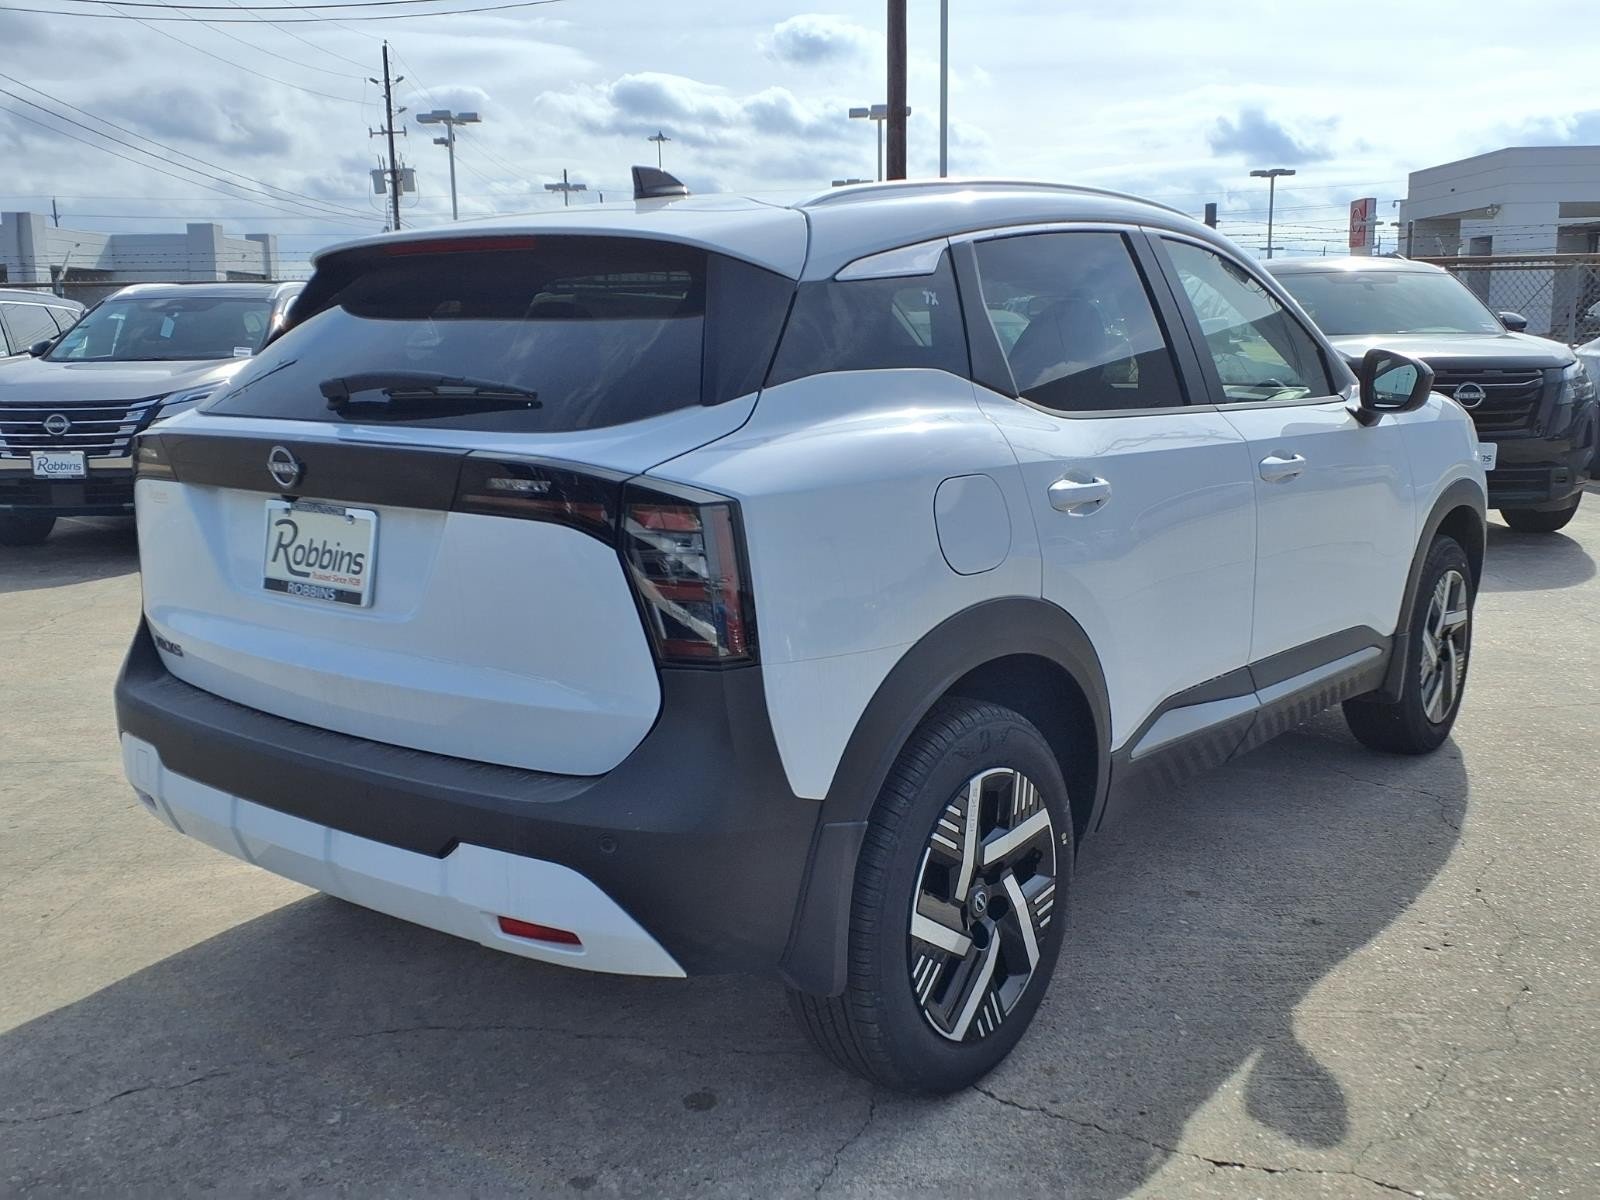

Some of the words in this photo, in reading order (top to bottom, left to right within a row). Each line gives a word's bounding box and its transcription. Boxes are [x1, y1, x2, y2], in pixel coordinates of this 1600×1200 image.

[37, 456, 82, 473] Robbins
[271, 518, 365, 578] Robbins
[287, 582, 336, 600] ROBBINS
